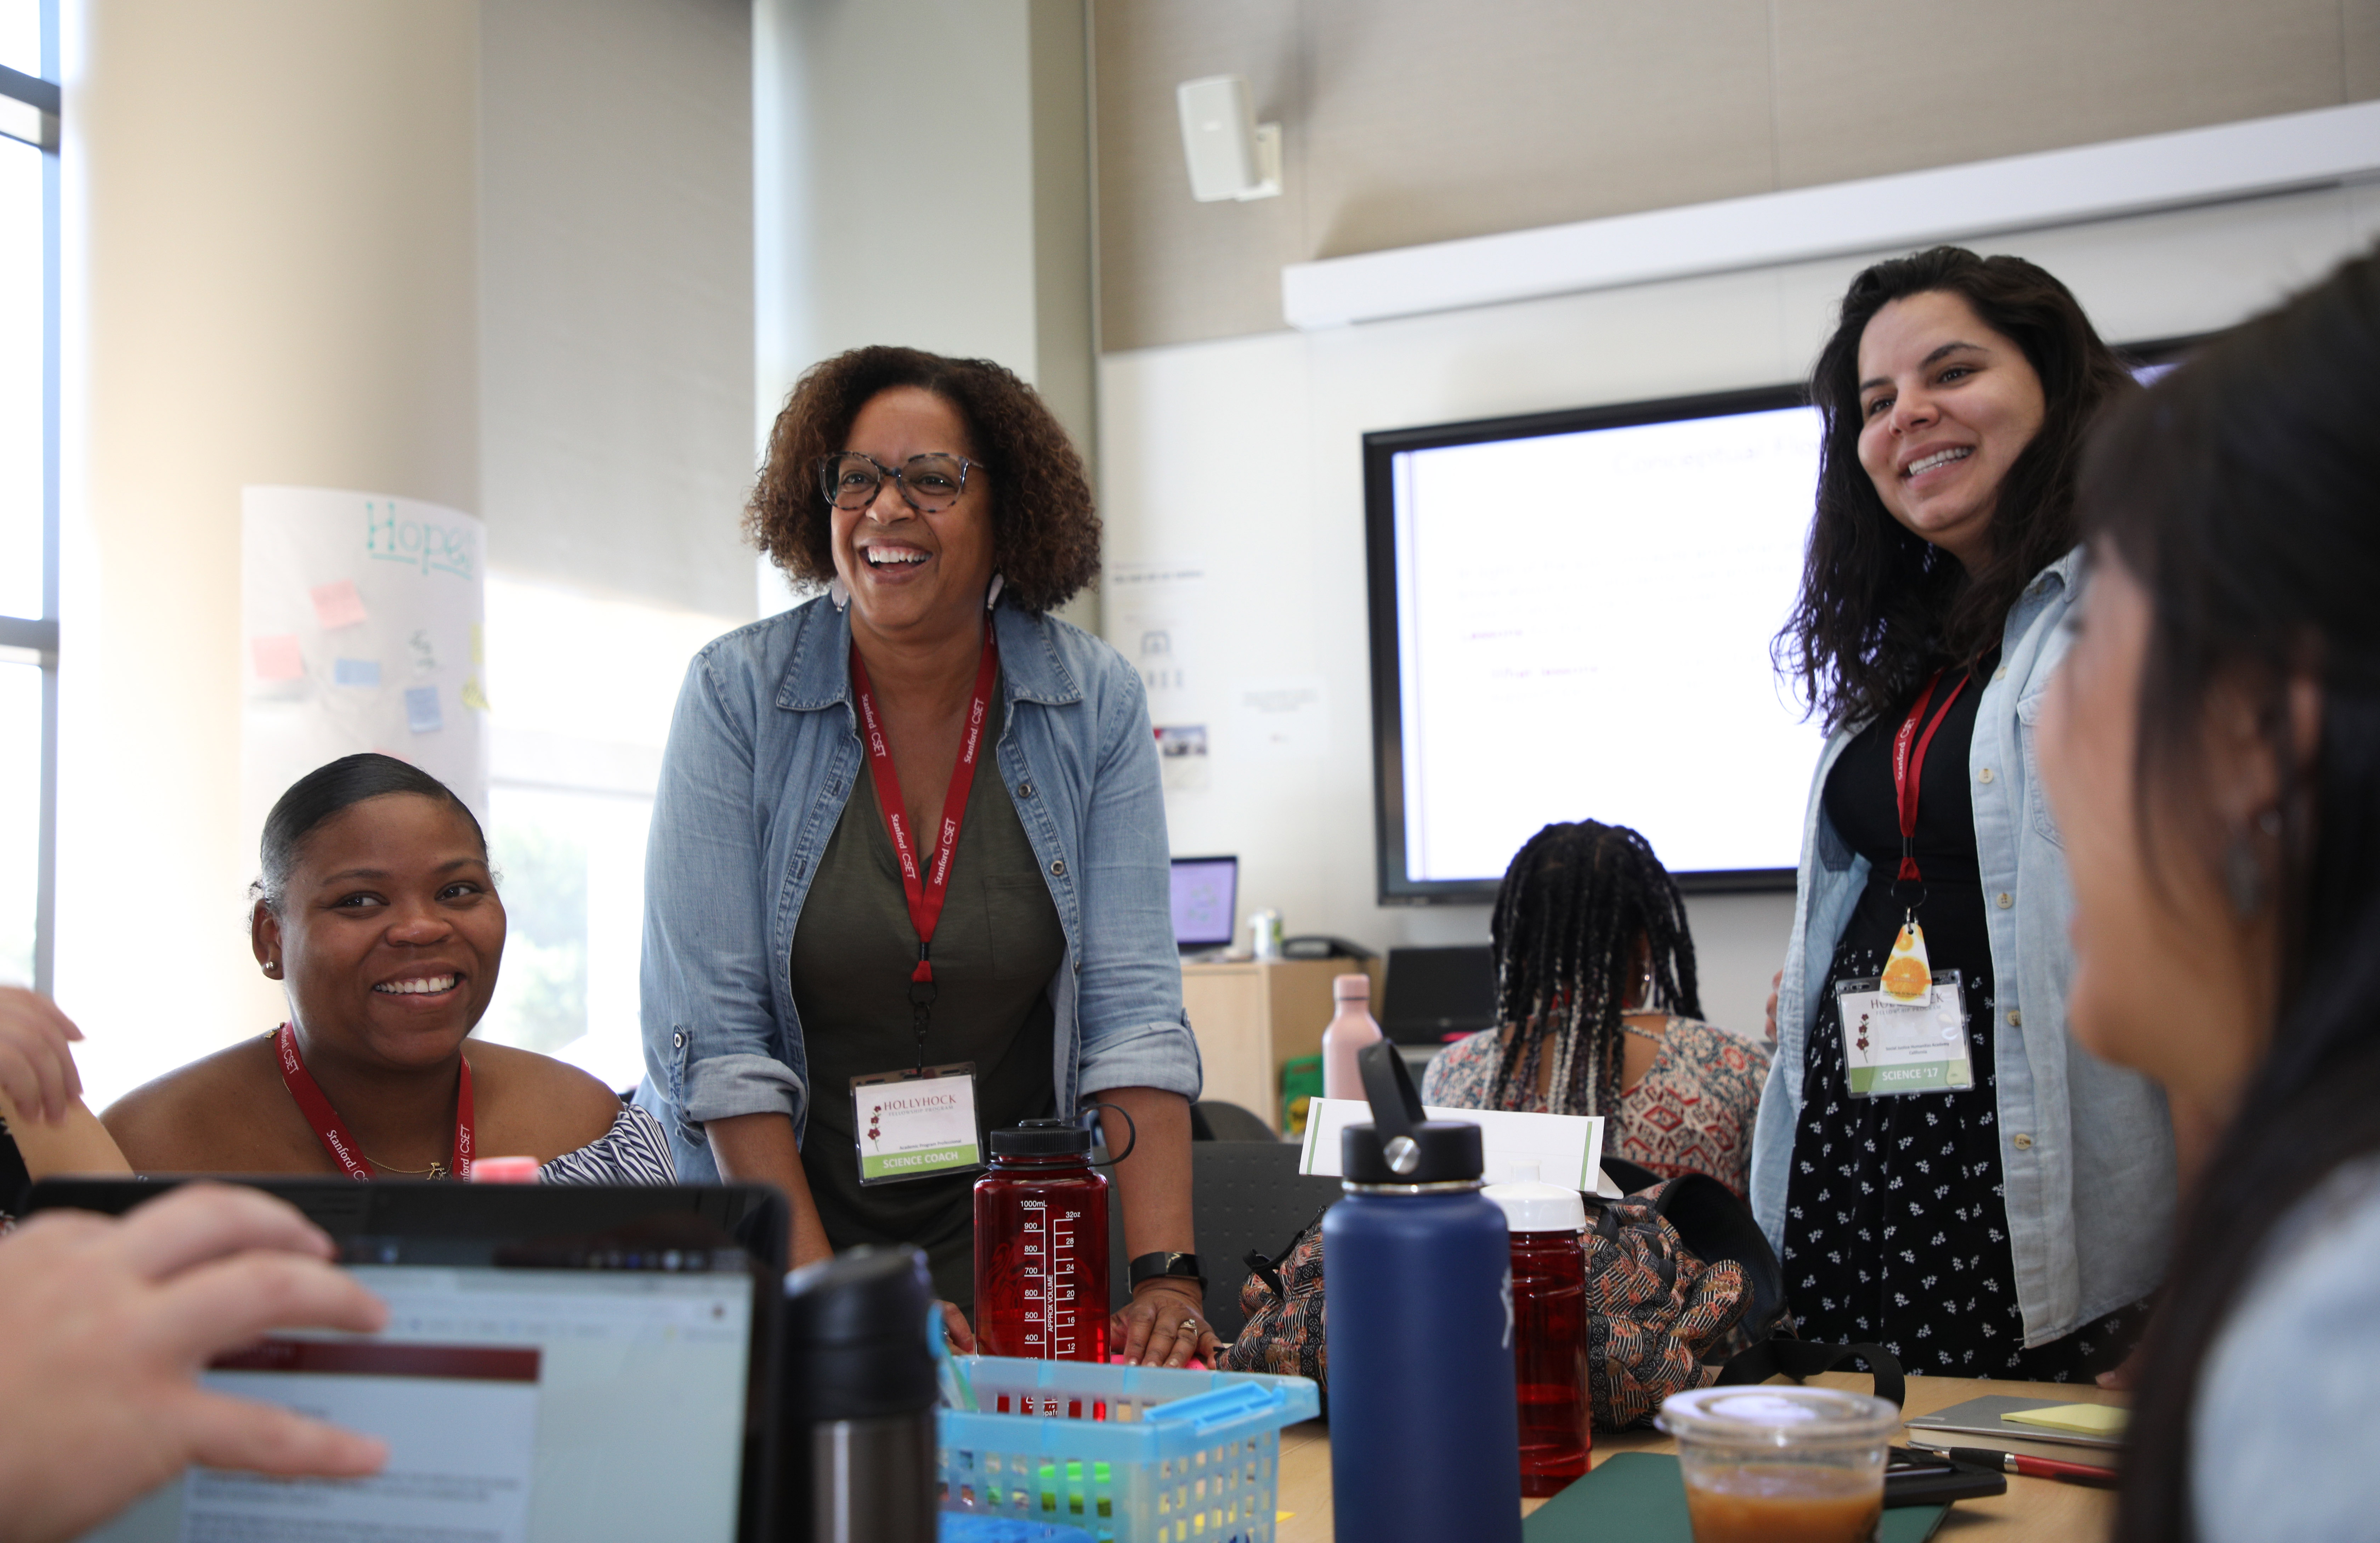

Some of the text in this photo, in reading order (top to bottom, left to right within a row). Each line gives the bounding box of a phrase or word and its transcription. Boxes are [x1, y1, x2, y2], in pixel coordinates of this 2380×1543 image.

[862, 694, 886, 757] Stanford CSET
[964, 698, 984, 764] Stanford CSET
[1897, 741, 1906, 781] Stanford
[891, 814, 916, 879] Stanford CSET
[934, 818, 956, 885] Stanford CSET
[284, 1049, 299, 1074] CSET
[1882, 1069, 1921, 1081] SCIENCE
[884, 1094, 956, 1111] HOLLYHOCK
[327, 1130, 357, 1168] Stanford
[460, 1124, 470, 1153] CSET
[883, 1151, 958, 1169] SCIENCE COACH
